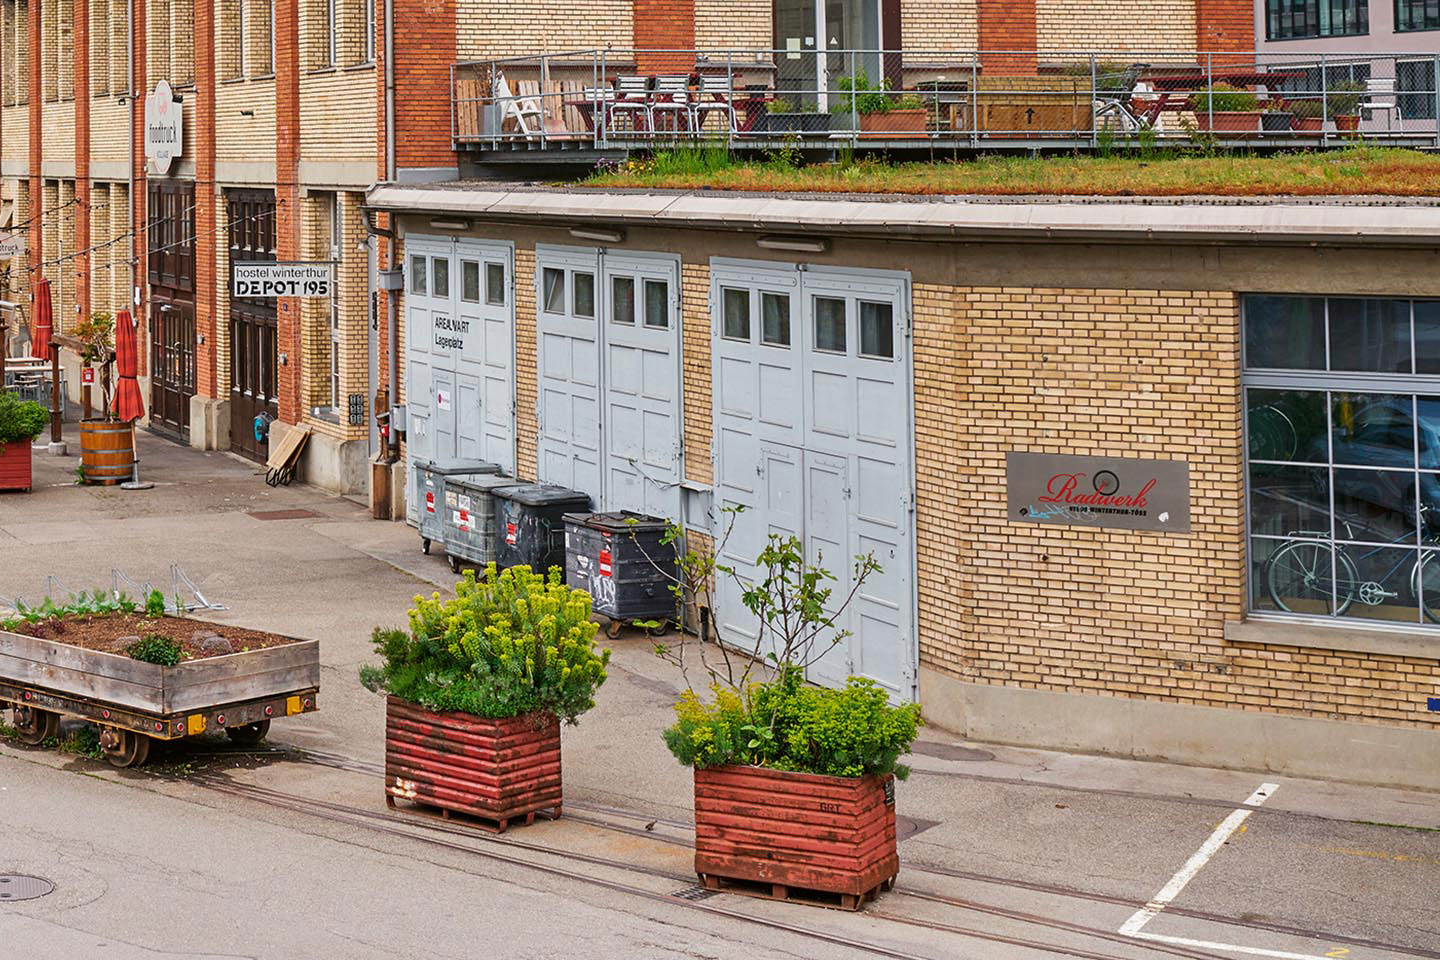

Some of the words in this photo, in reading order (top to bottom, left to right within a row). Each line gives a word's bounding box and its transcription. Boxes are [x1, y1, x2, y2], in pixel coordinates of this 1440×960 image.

[149, 121, 177, 144] foodtruck
[236, 267, 269, 279] hostel
[272, 267, 328, 279] winterthur
[236, 281, 300, 295] DEPOT
[303, 281, 328, 295] 195
[1038, 472, 1157, 508] Radwerk
